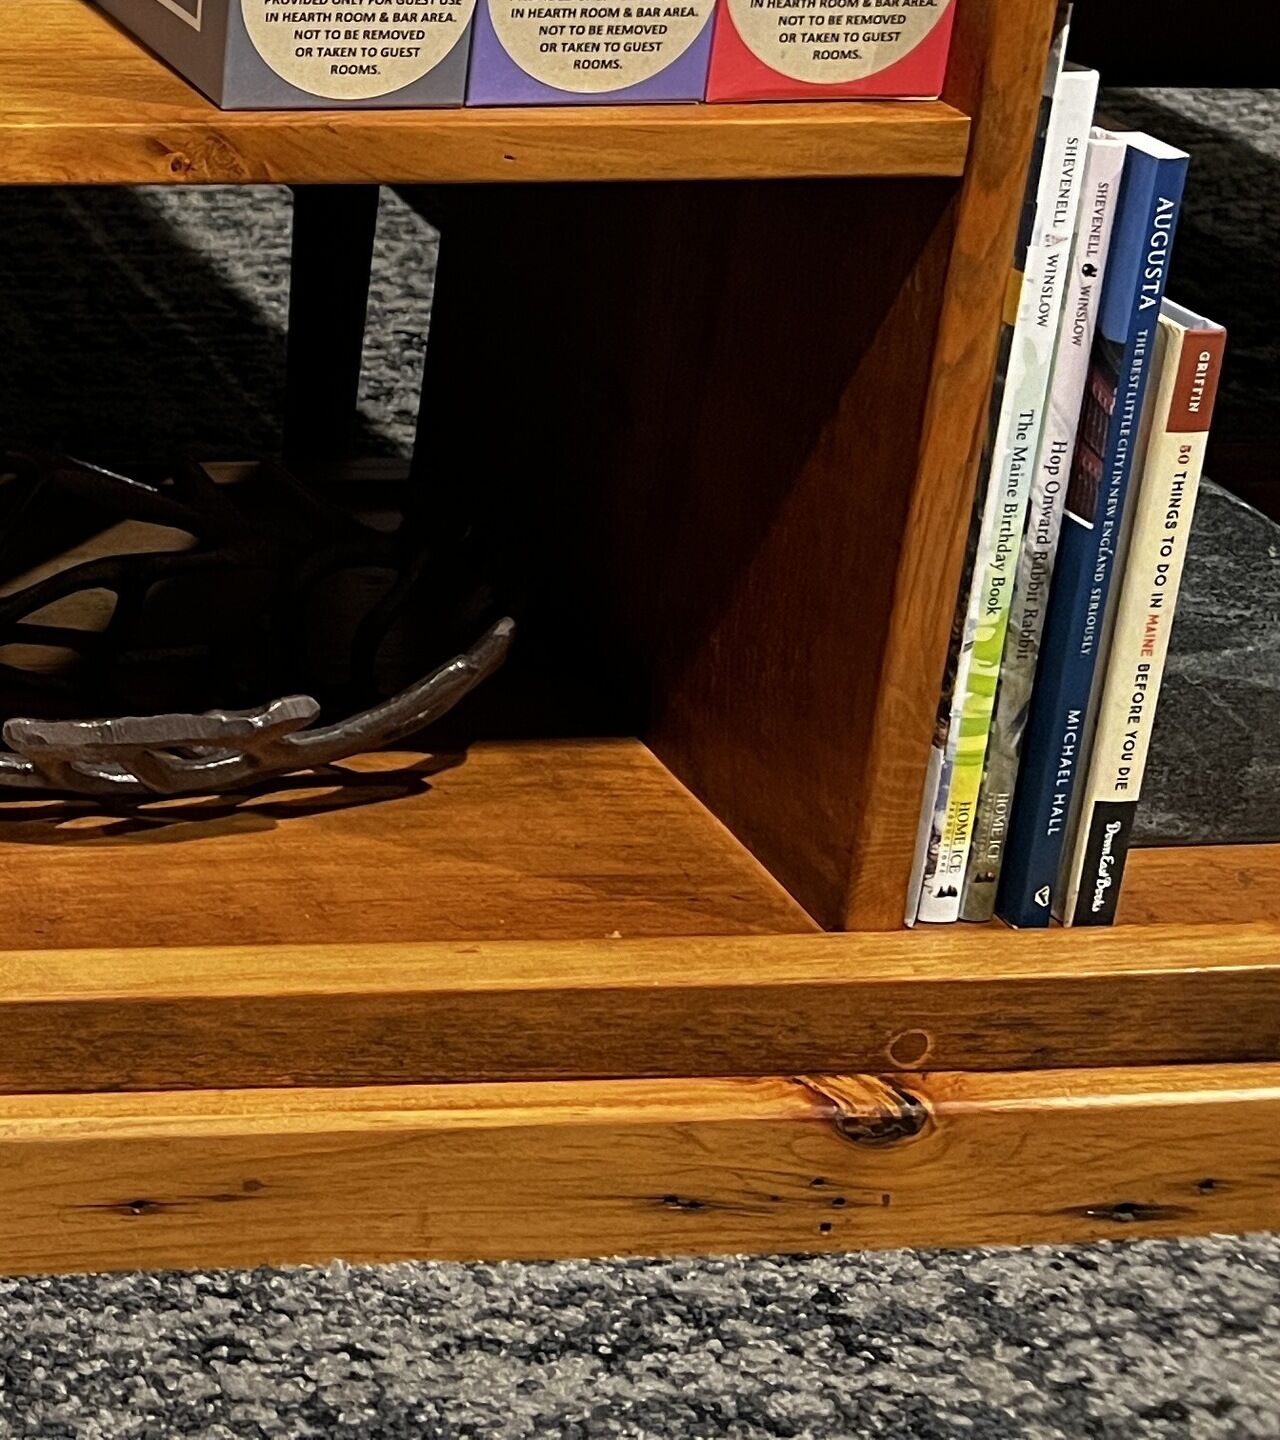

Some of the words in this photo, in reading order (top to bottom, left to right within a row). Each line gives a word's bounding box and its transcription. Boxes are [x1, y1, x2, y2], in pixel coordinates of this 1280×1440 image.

[265, 12, 279, 23] IN
[282, 12, 332, 23] HEARTH
[335, 12, 376, 23] ROOM
[379, 12, 389, 23] &
[392, 12, 418, 23] BAR
[420, 12, 457, 23] AREA.
[294, 29, 322, 40] NOT
[325, 29, 341, 40] TO
[344, 29, 359, 40] BE
[362, 29, 426, 40] REMOVED
[295, 47, 313, 58] OR
[316, 47, 357, 58] TAKEN
[361, 47, 377, 58] TO
[380, 47, 421, 58] GUEST
[330, 65, 381, 75] ROOMS.
[1052, 136, 1079, 228] SHEVENELL
[1086, 182, 1109, 258] SHEVENELL
[1138, 196, 1175, 311] AUGUSTA
[1035, 254, 1059, 328] WINSLOW
[1072, 284, 1093, 347] WINSLOW
[1133, 329, 1149, 356] THE
[1128, 358, 1143, 389] BEST
[1187, 351, 1211, 414] GRIFFIN
[1015, 409, 1034, 441] The
[1119, 392, 1138, 436] LITTLE
[1006, 447, 1028, 498] Maine
[1043, 441, 1067, 476] Hop
[1113, 438, 1129, 468] CITY
[1111, 470, 1123, 485] IN
[1036, 480, 1061, 545] Onward
[1106, 487, 1120, 518] NEW
[1164, 470, 1187, 530] THINGS
[989, 502, 1018, 572] Birthday
[1093, 520, 1114, 582] ENGLAND
[1160, 535, 1174, 557] TO
[1028, 551, 1048, 595] Rabbit
[1154, 564, 1169, 586] DO
[986, 576, 1006, 616] Book
[1150, 593, 1163, 608] IN
[1015, 608, 1038, 661] Rabbit
[1140, 614, 1160, 657] MAINE
[1127, 663, 1151, 724] BEFORE
[1055, 710, 1081, 787] MICHAEL
[1120, 730, 1137, 762] YOU
[1114, 767, 1129, 791] DIE
[953, 801, 972, 845] HOME
[1047, 794, 1066, 836] HALL
[948, 850, 964, 874] ICE
